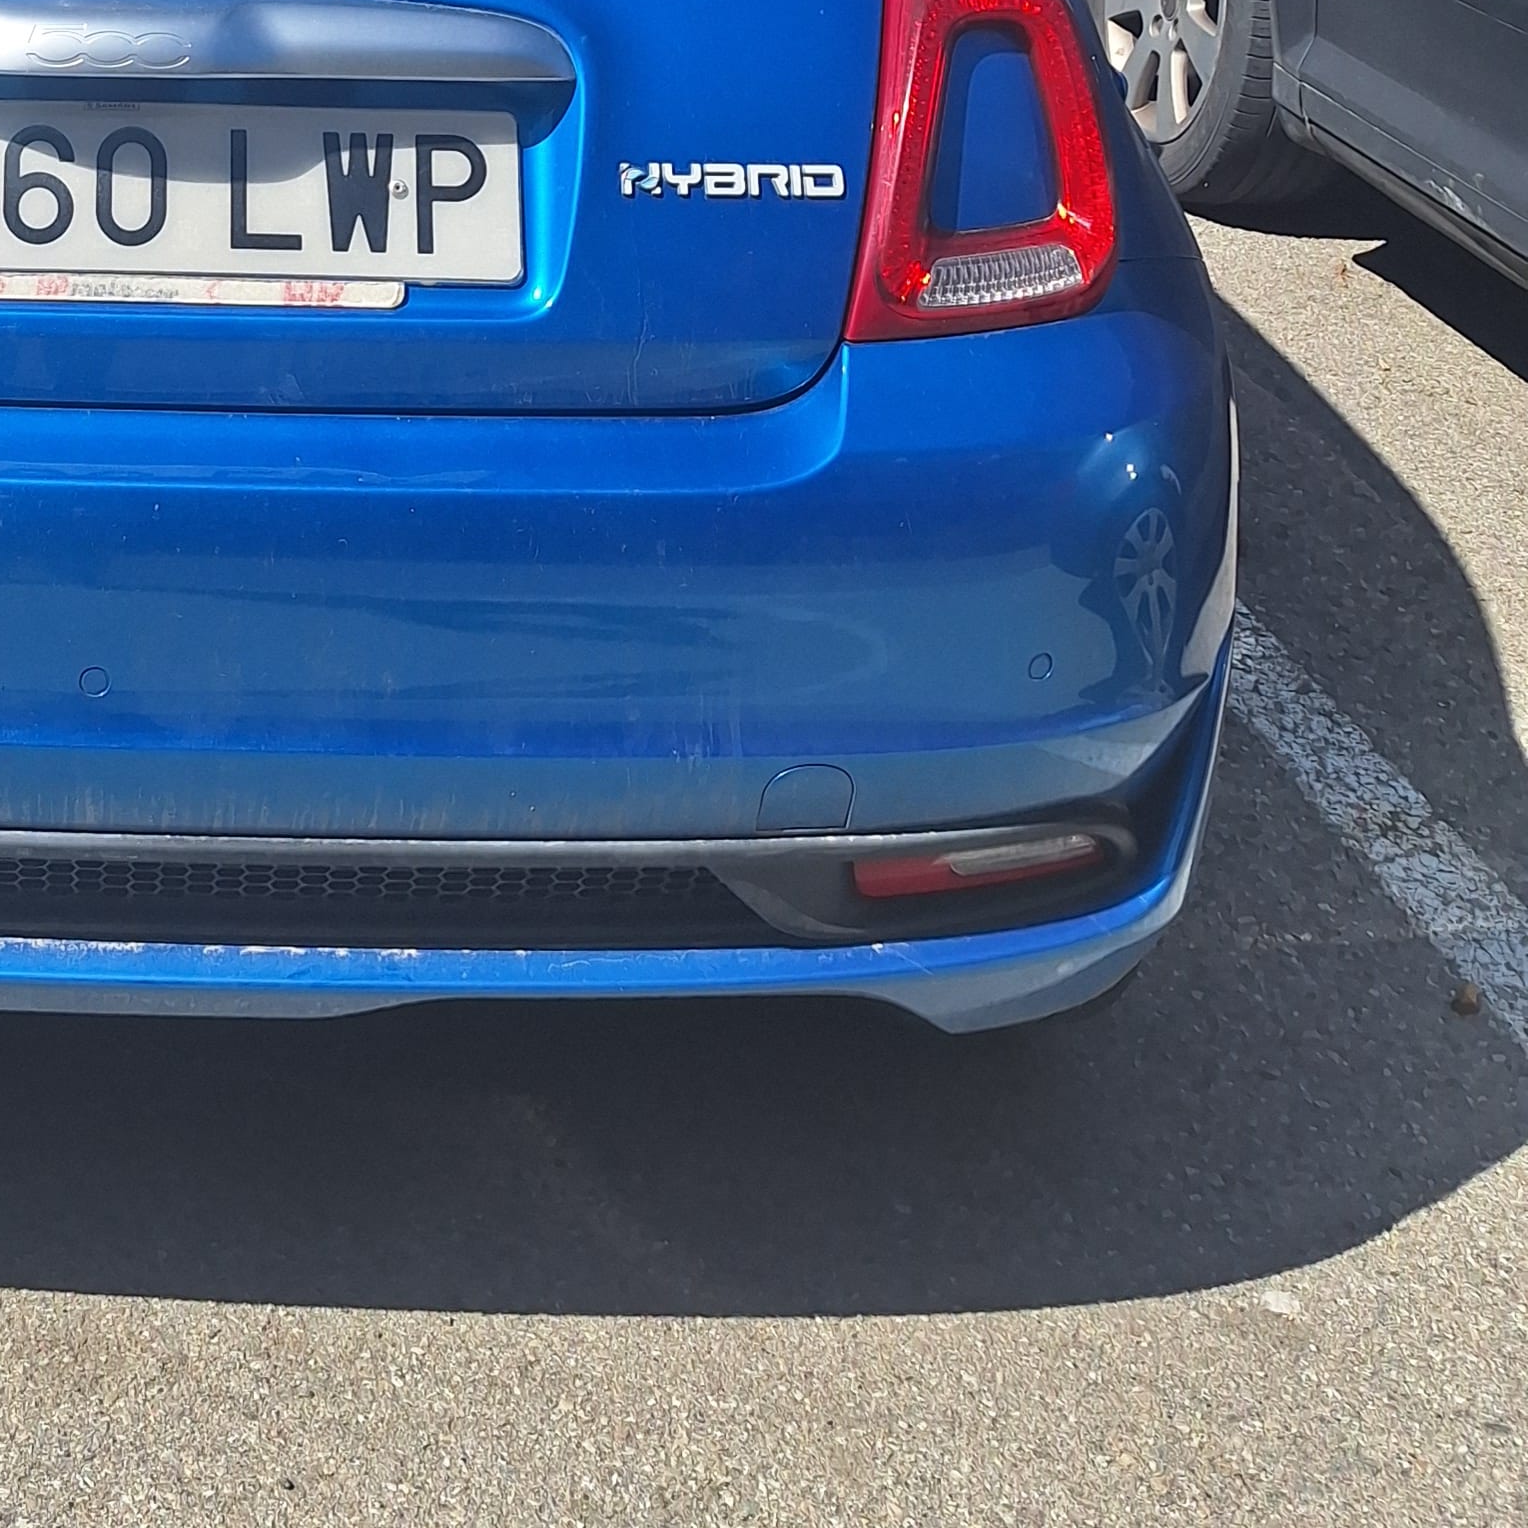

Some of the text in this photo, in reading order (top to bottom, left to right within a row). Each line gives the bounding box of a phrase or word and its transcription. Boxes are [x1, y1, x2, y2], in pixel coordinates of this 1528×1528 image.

[26, 23, 191, 69] 500
[229, 128, 488, 255] LWP
[619, 162, 845, 197] HYBRID
